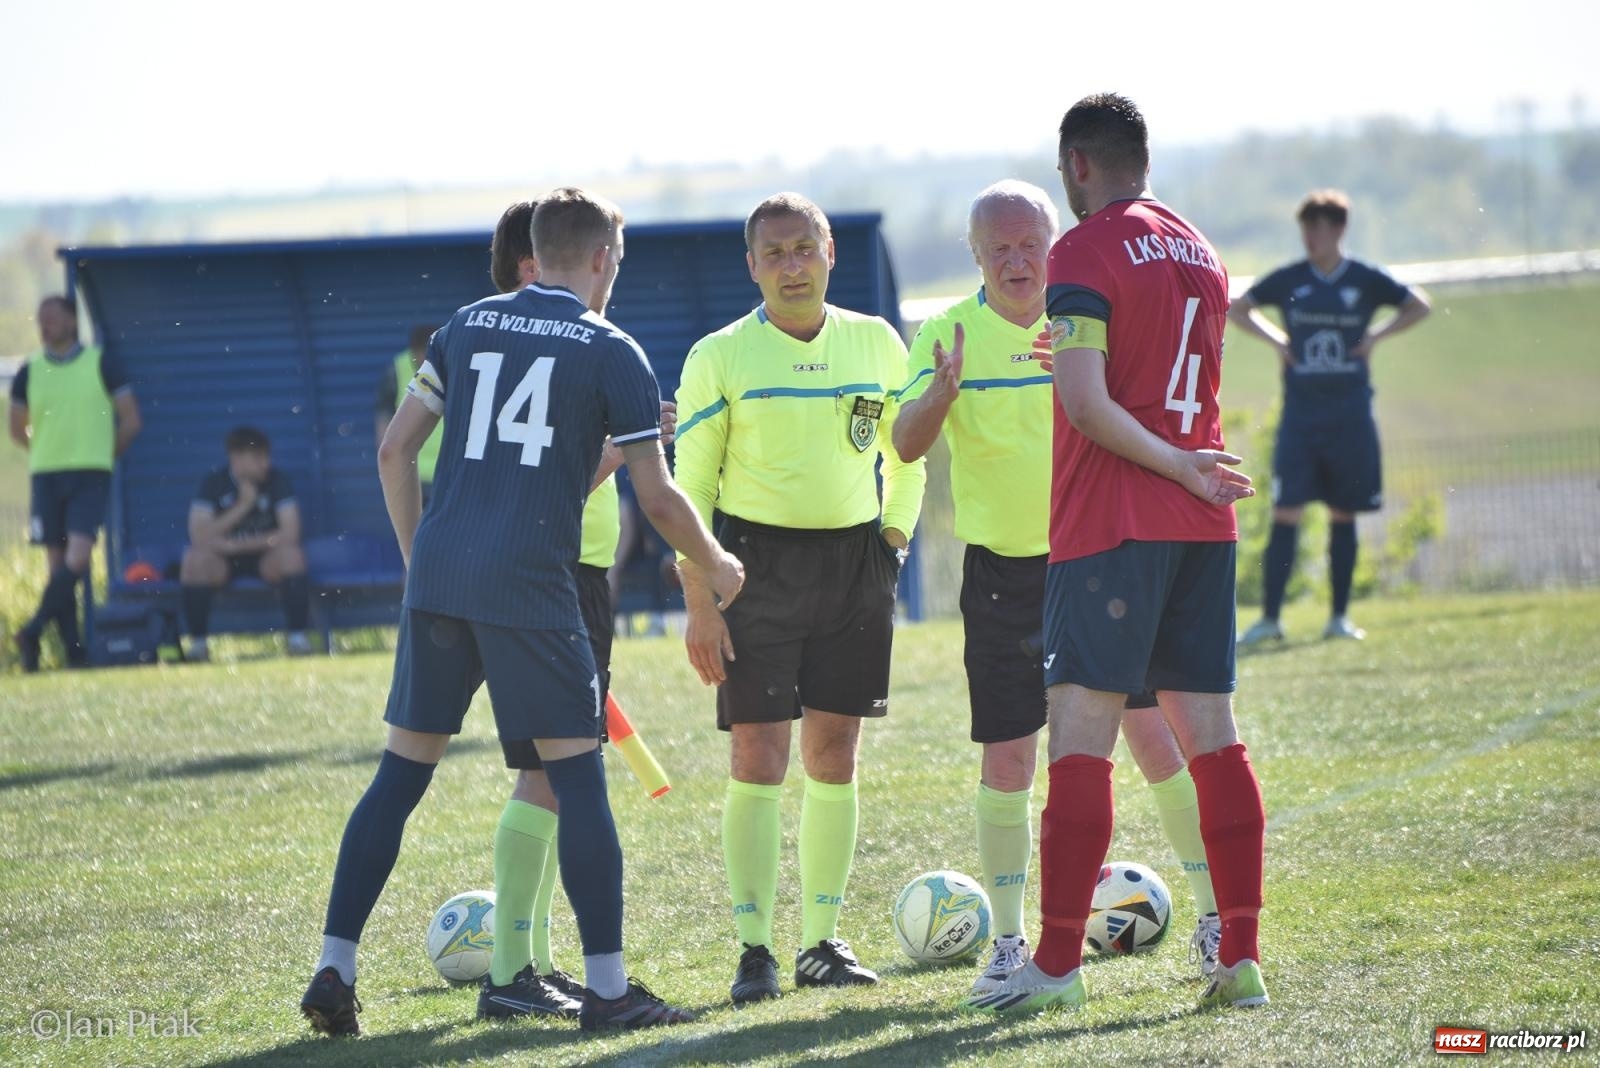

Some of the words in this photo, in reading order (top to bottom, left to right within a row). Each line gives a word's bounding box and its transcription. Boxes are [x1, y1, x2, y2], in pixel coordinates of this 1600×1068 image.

[1123, 234, 1167, 265] LKS
[465, 310, 499, 328] LKS
[498, 314, 596, 345] WOJNOWICE
[1165, 297, 1203, 434] 4
[463, 351, 557, 468] 14
